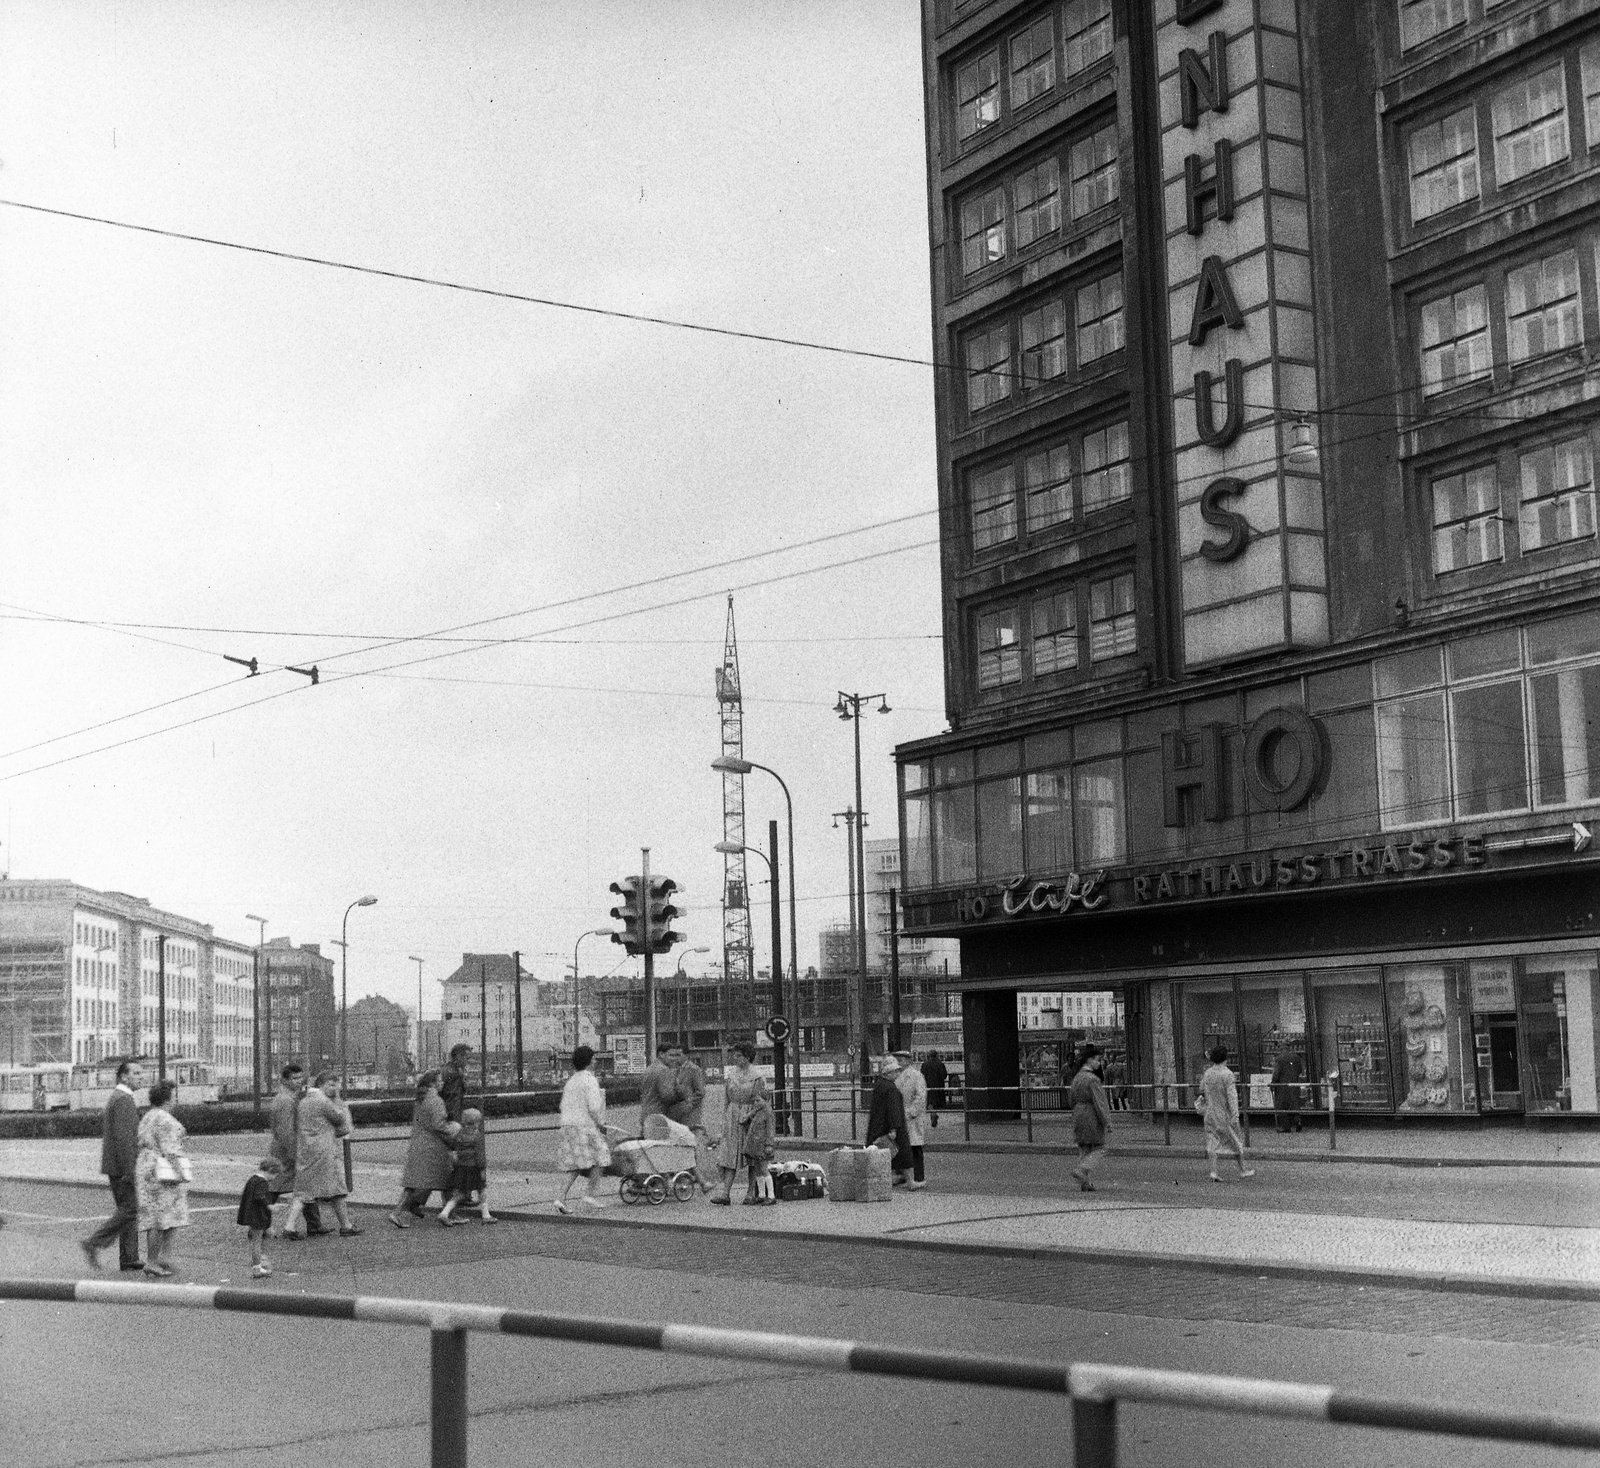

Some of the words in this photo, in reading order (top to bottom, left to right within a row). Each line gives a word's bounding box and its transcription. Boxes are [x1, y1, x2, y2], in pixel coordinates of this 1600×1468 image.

[1161, 706, 1326, 827] HO
[957, 896, 986, 920] HO
[1001, 869, 1108, 914] Café
[1133, 834, 1485, 901] RATHAUSSTRASSE
